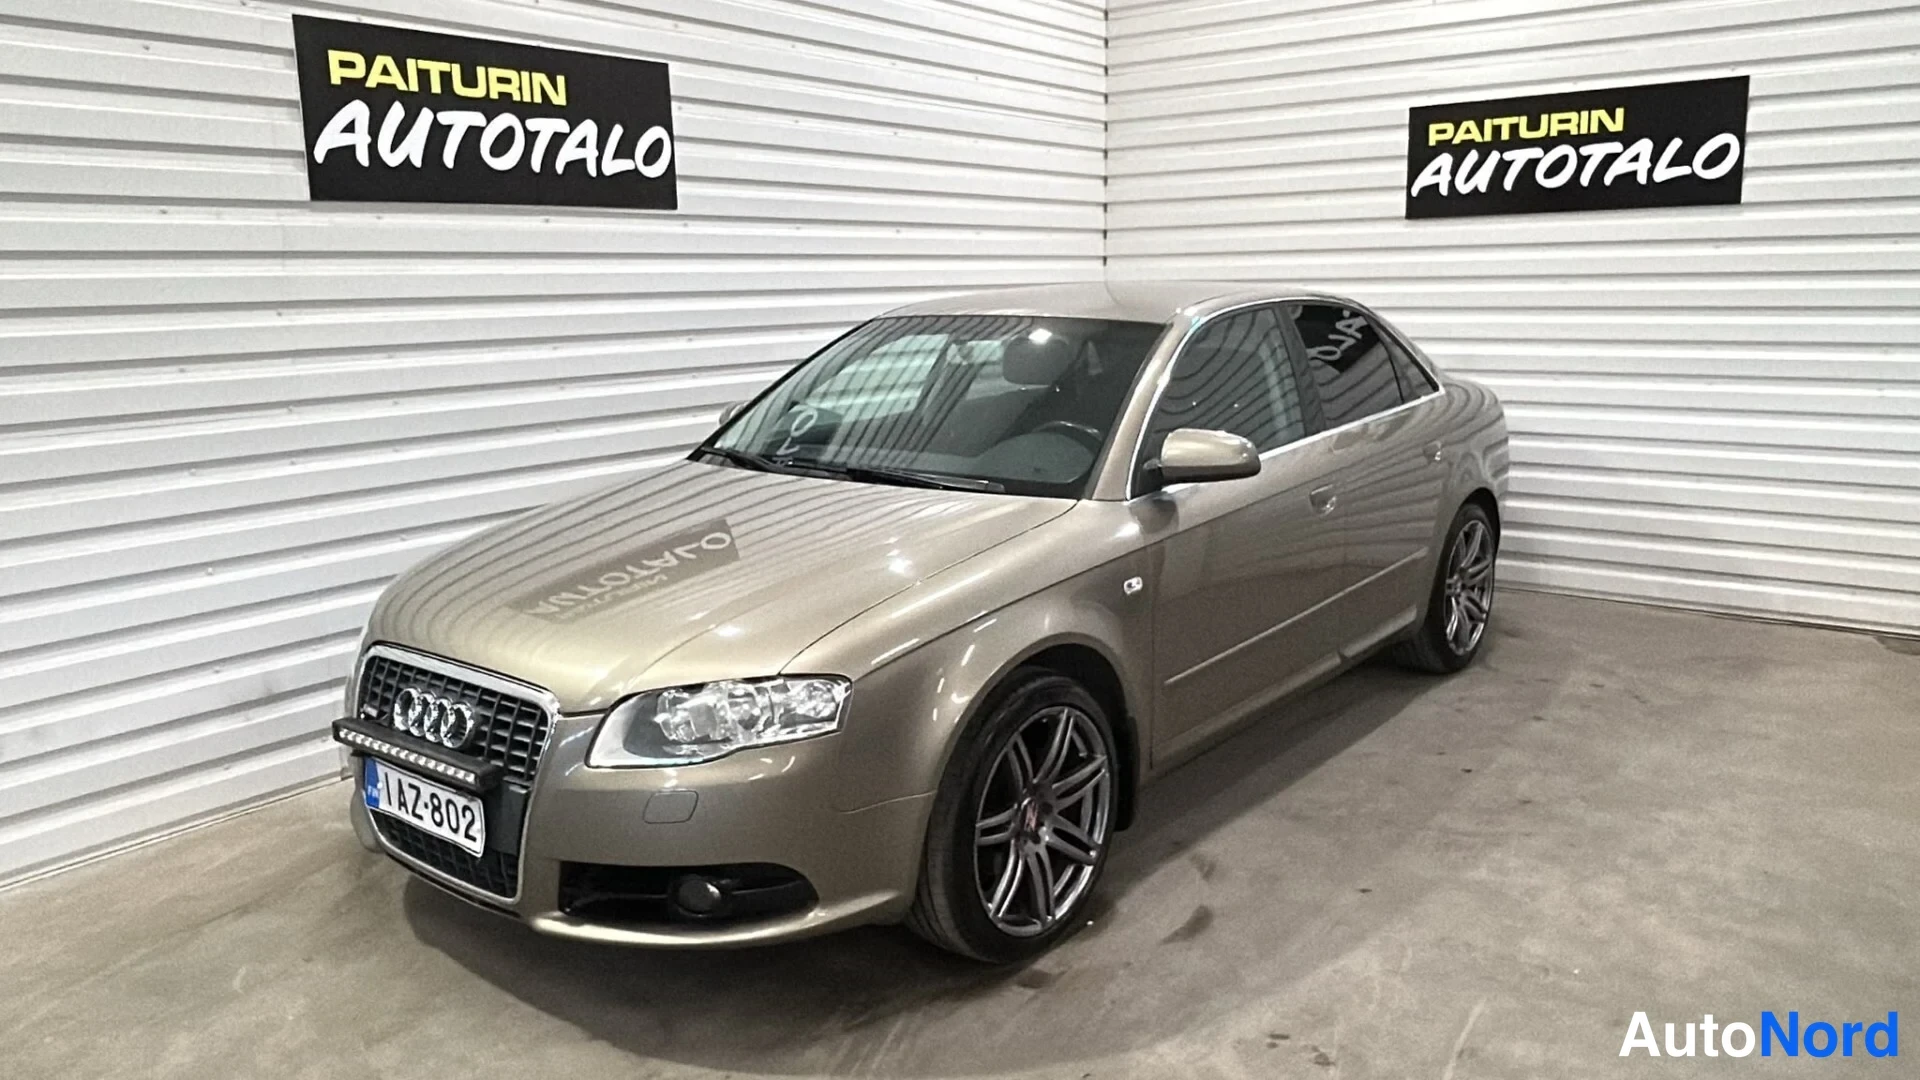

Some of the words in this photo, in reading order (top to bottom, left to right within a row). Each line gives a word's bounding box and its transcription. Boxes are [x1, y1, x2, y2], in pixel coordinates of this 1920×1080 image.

[327, 49, 567, 106] PAITURIN
[313, 99, 672, 179] AUTOTALO
[1428, 107, 1625, 146] PAITURIN
[1410, 132, 1740, 198] AUTOTALO
[384, 771, 477, 843] IAZ-802
